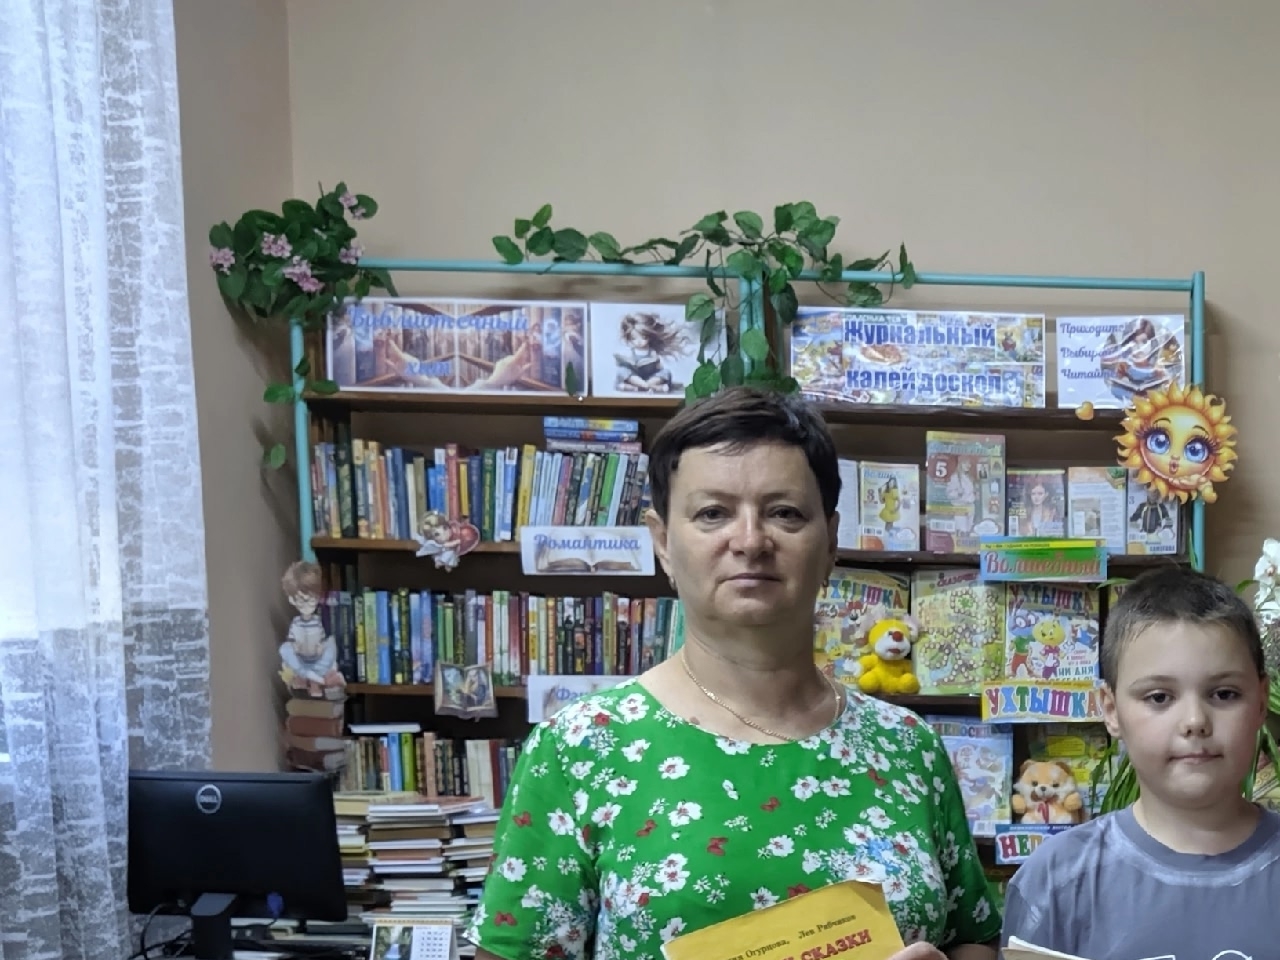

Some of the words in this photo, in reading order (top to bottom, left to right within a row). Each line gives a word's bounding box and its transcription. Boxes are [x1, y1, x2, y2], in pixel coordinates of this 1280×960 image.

[844, 320, 997, 347] Журнальный
[845, 367, 1007, 394] калейдоскоп
[935, 461, 948, 478] 5
[533, 533, 641, 551] Романтика
[985, 549, 1101, 577] Волшебный
[1009, 584, 1094, 611] УХТЫШКА
[986, 686, 1103, 718] УХТЫШКА
[999, 834, 1044, 859] НЕП
[798, 929, 816, 940] Лев
